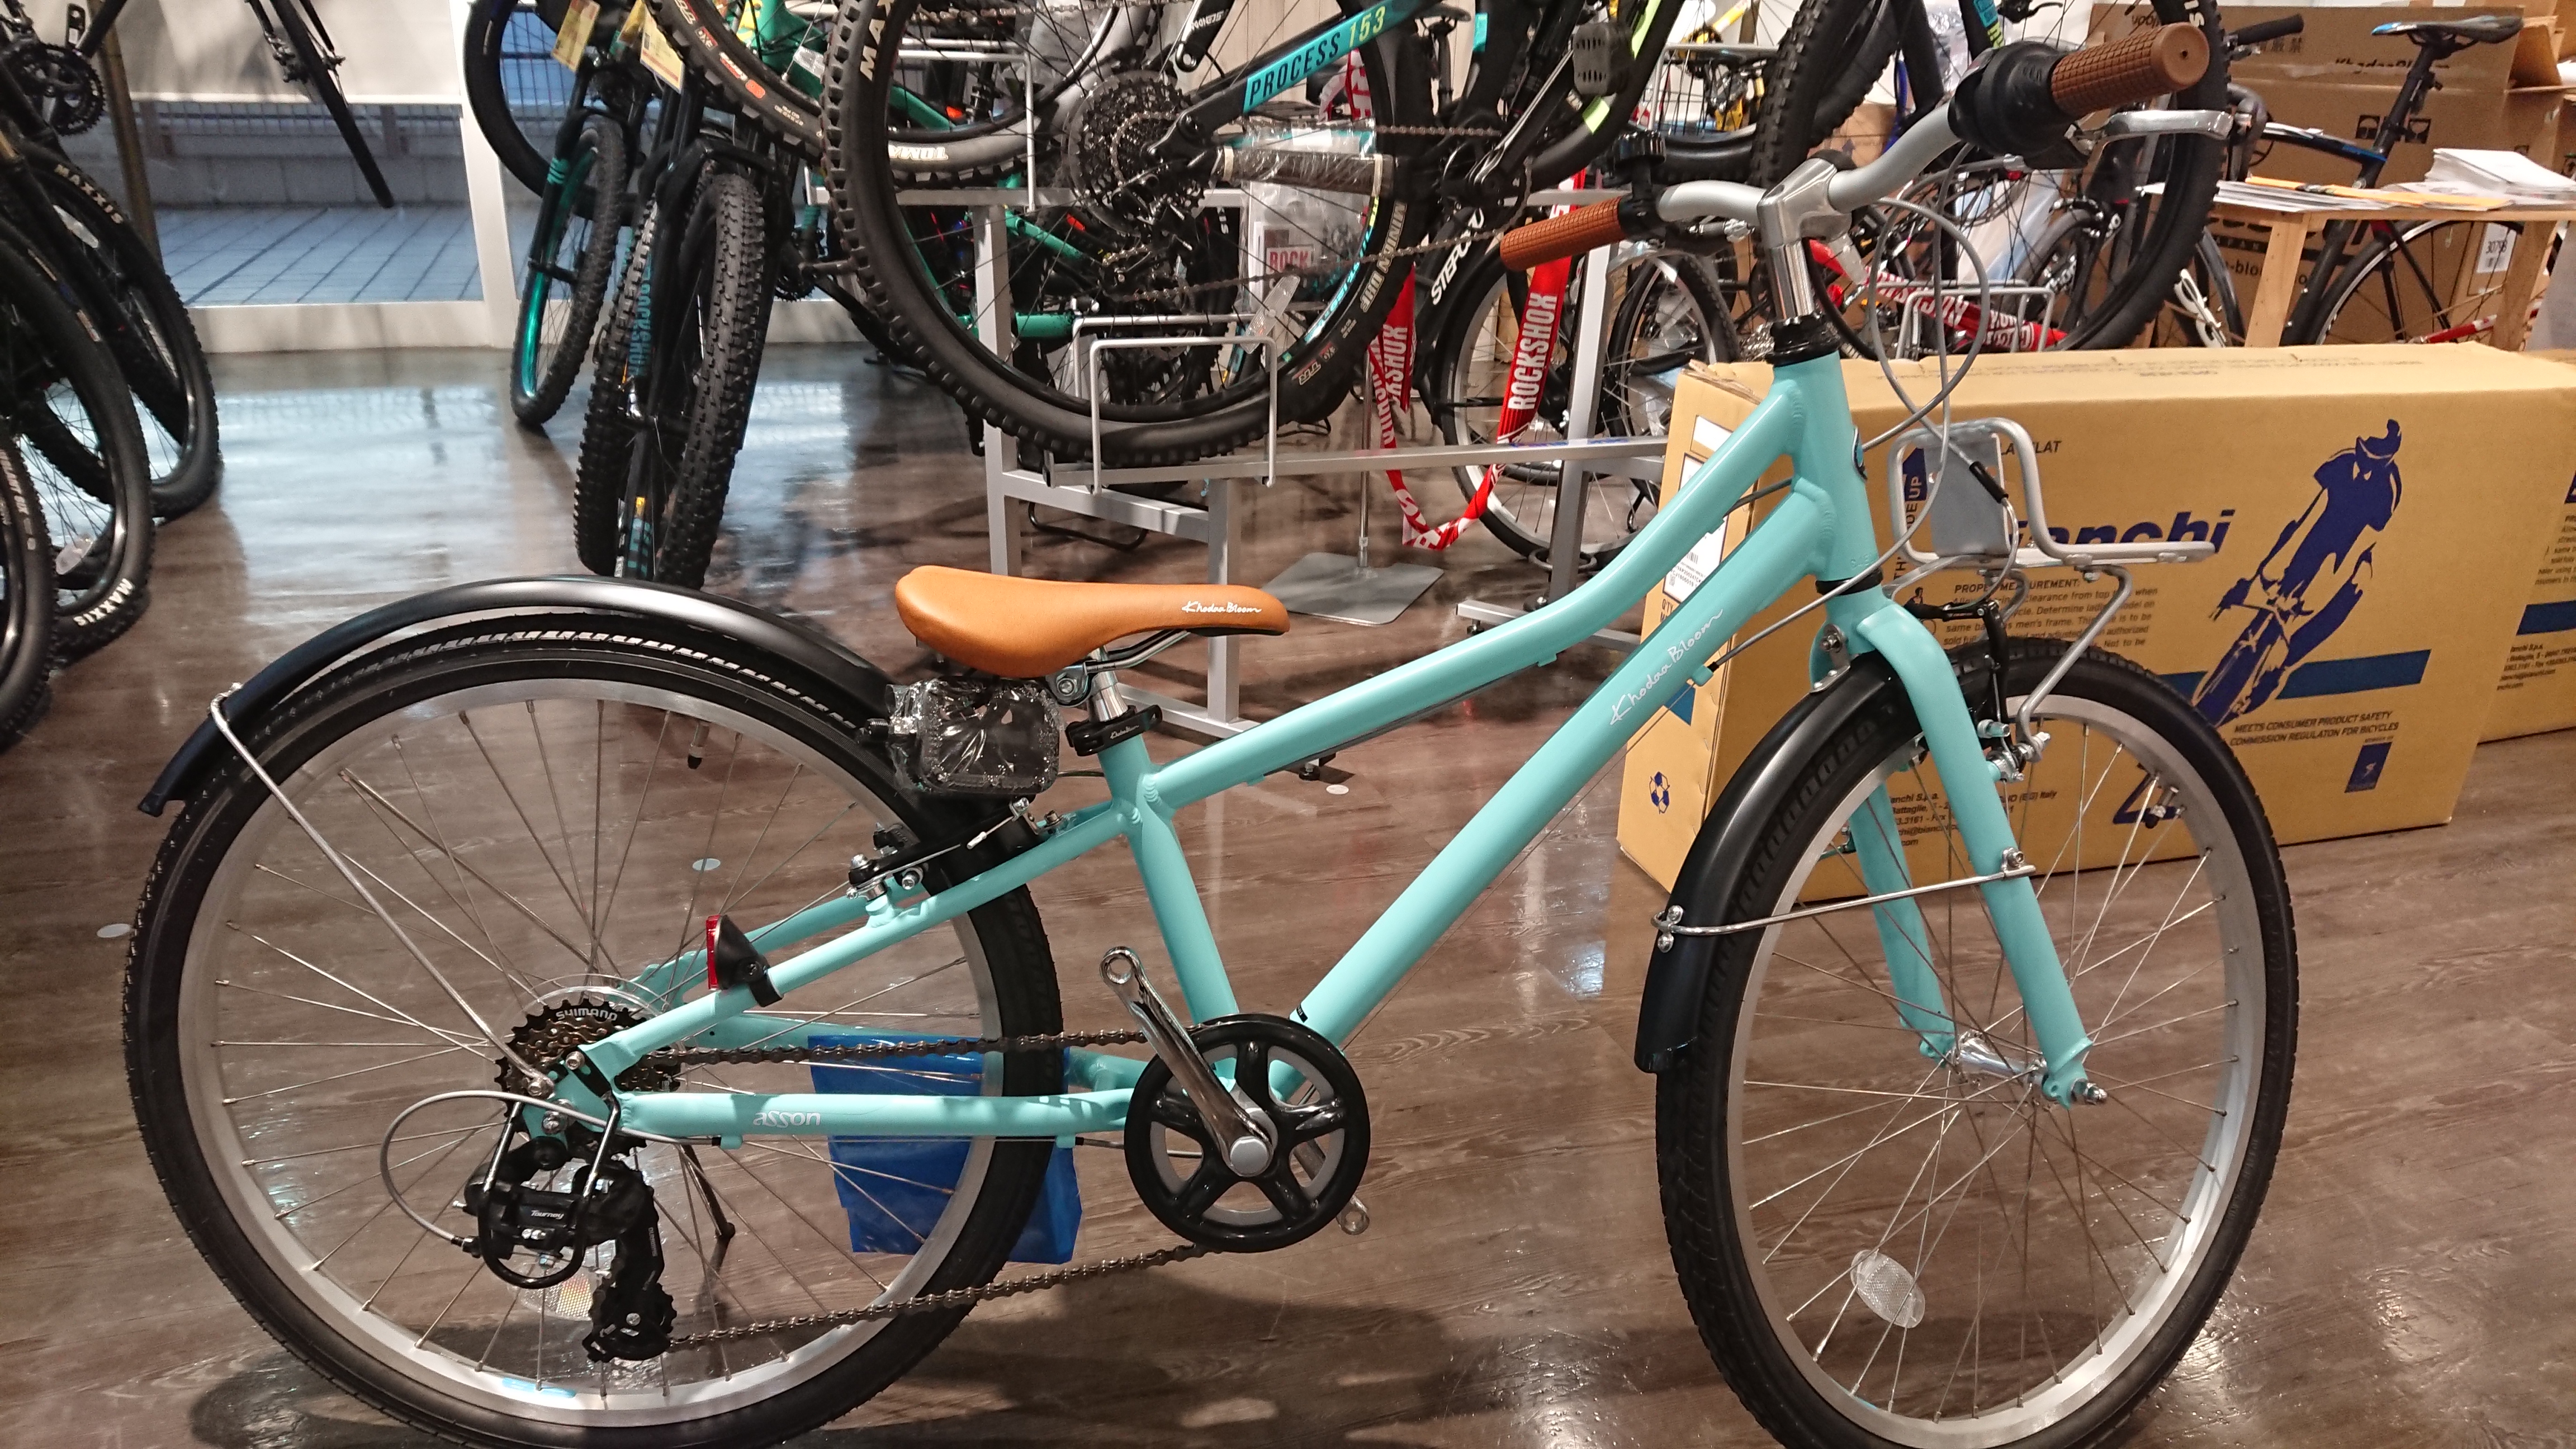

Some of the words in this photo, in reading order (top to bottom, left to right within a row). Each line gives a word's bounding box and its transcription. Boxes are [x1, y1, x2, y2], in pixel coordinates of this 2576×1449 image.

[1249, 31, 1341, 106] PROCESS
[1348, 6, 1386, 49] 153
[54, 164, 123, 224] MAXXIS
[1270, 250, 1309, 273] ROCK
[1360, 270, 1385, 312] DHF
[1508, 291, 1558, 410] ROCKSHOX
[1299, 361, 1322, 386] TR
[2034, 439, 2062, 454] LAT
[1908, 476, 1922, 499] UP
[1954, 584, 1993, 594] PROPE
[2000, 578, 2081, 591] MEUREMENT:
[2072, 593, 2091, 602] from
[2135, 588, 2158, 596] when
[73, 578, 134, 626] MAXXIS
[2037, 604, 2083, 615] Determine
[1945, 623, 1971, 633] same
[2015, 619, 2042, 629] men's
[2045, 617, 2074, 627] frame.
[2234, 722, 2265, 733] MEETS
[2266, 718, 2318, 731] CONSUMER
[2318, 713, 2359, 726] PRODUCT
[2359, 710, 2393, 722] SAFETY
[2230, 733, 2288, 746] COMMISSION
[2340, 724, 2359, 735] FOR
[2359, 722, 2400, 733] BICYCLES
[556, 1007, 618, 1022] SHIMANO
[752, 1110, 821, 1129] asson
[531, 1209, 565, 1220] Tourney
